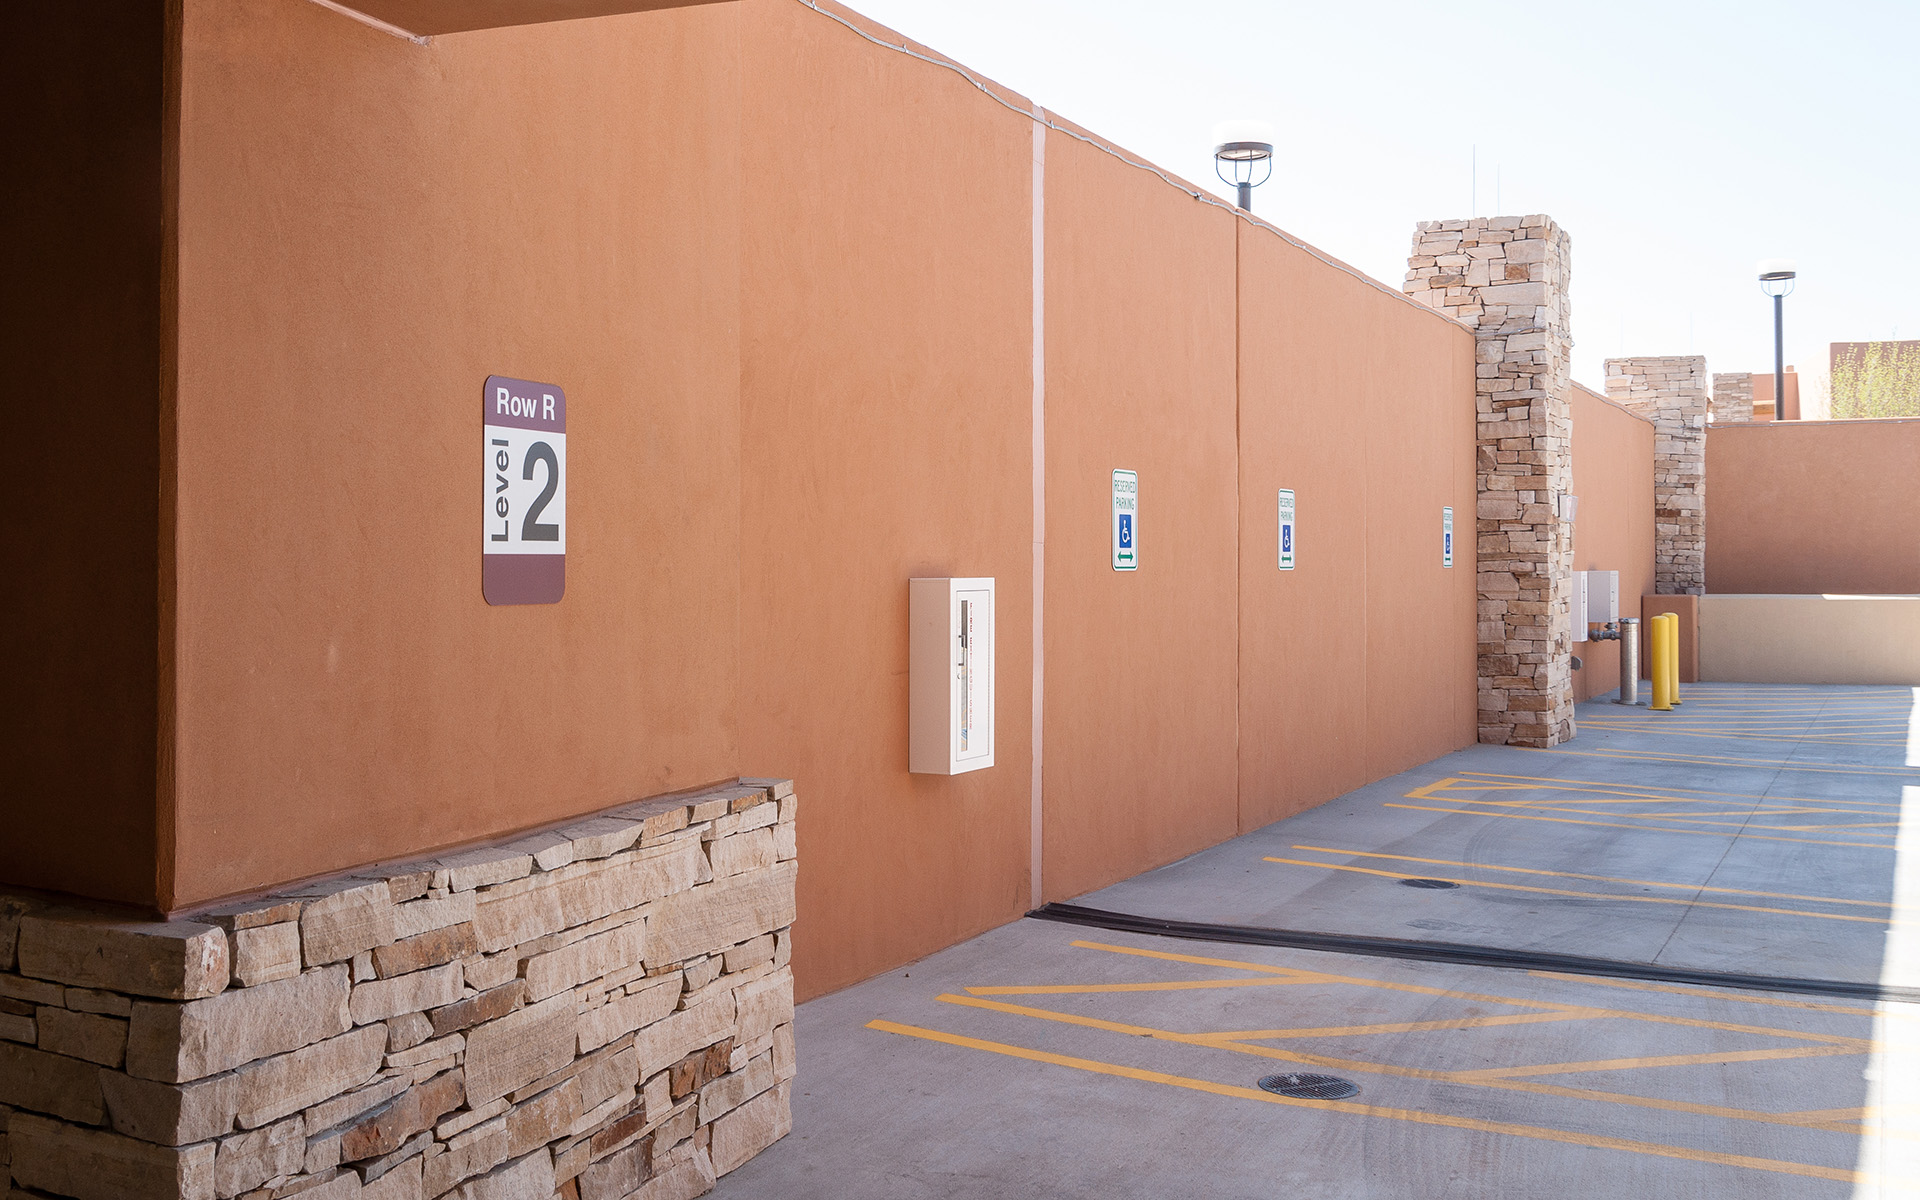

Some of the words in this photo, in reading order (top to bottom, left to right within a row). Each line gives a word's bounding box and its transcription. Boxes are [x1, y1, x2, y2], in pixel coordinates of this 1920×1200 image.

[497, 387, 537, 418] Row
[542, 394, 555, 421] R
[491, 438, 509, 542] Level
[521, 441, 559, 542] 2
[1114, 480, 1136, 494] RESERVED
[1116, 496, 1134, 510] PARKING
